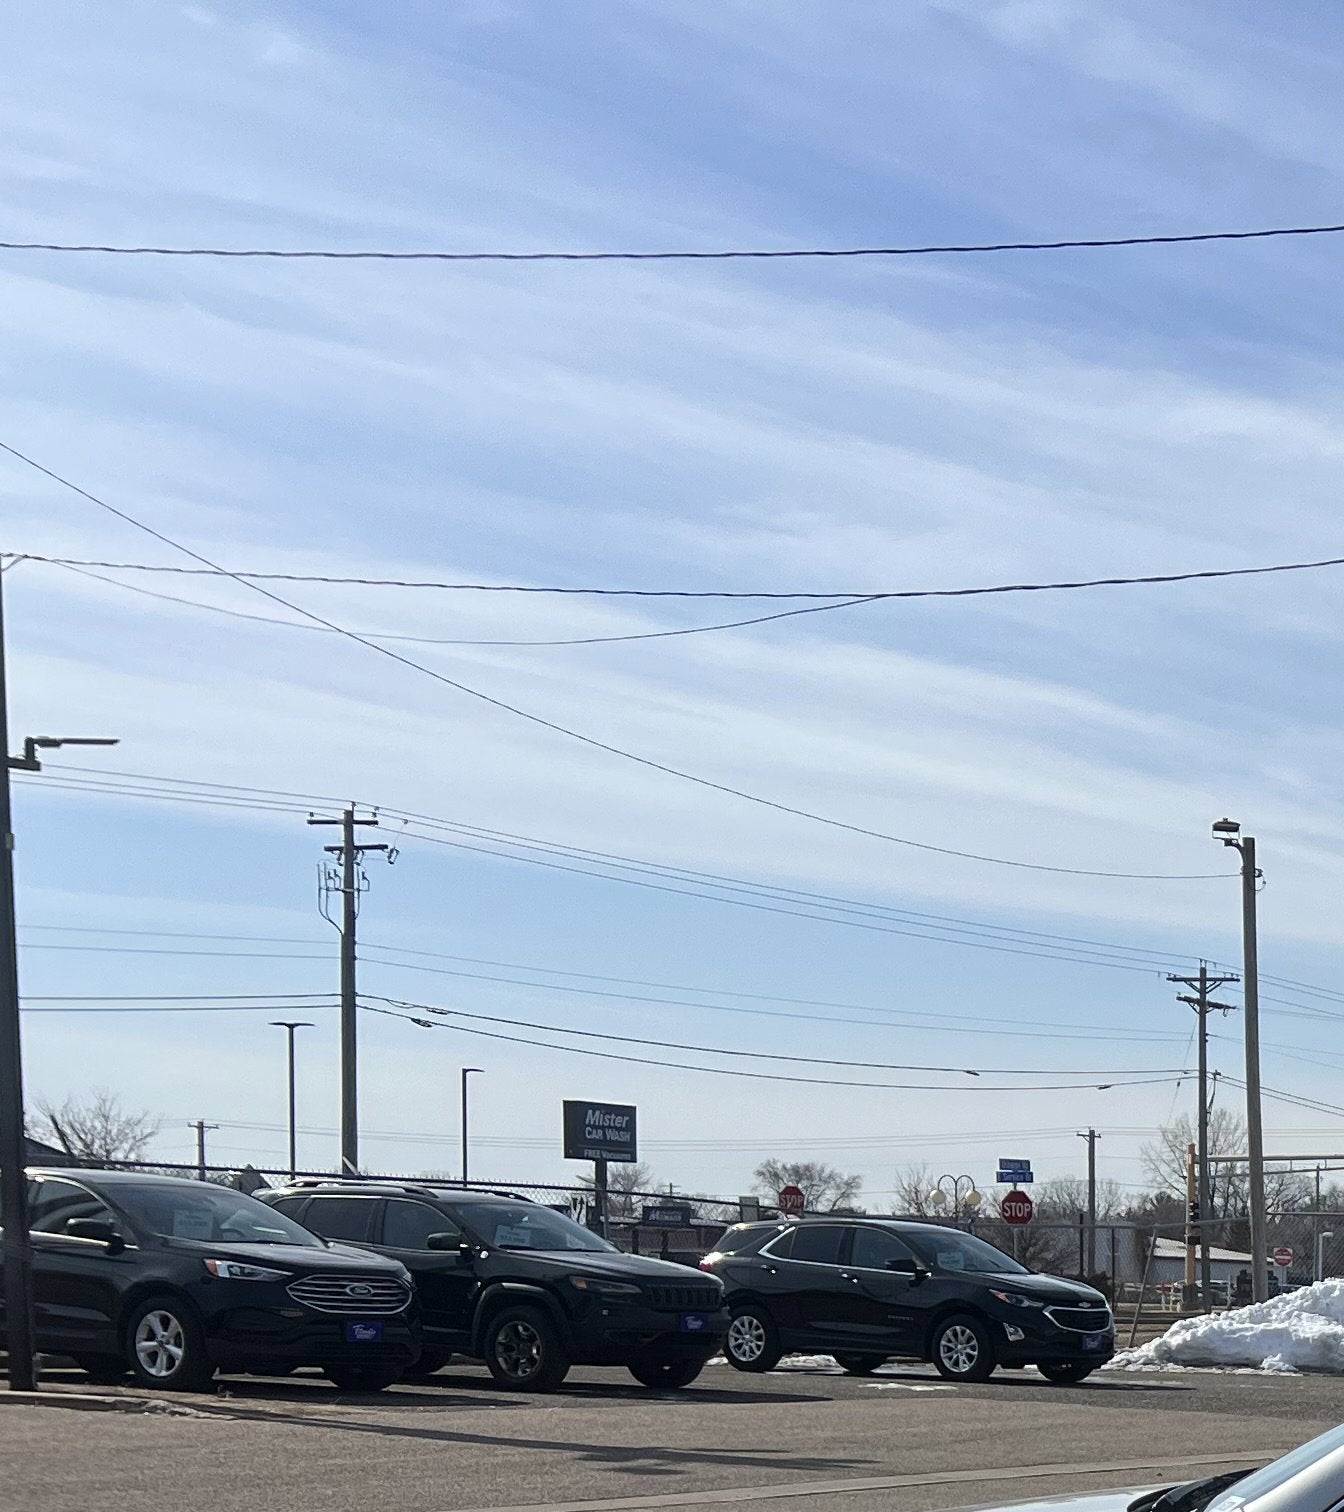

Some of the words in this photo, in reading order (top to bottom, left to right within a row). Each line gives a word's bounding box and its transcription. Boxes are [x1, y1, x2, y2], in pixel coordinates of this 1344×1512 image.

[585, 1110, 630, 1128] Mister
[585, 1127, 603, 1140] CAR
[605, 1129, 631, 1142] WASH
[780, 1194, 804, 1209] STOP
[1003, 1202, 1031, 1218] STOP
